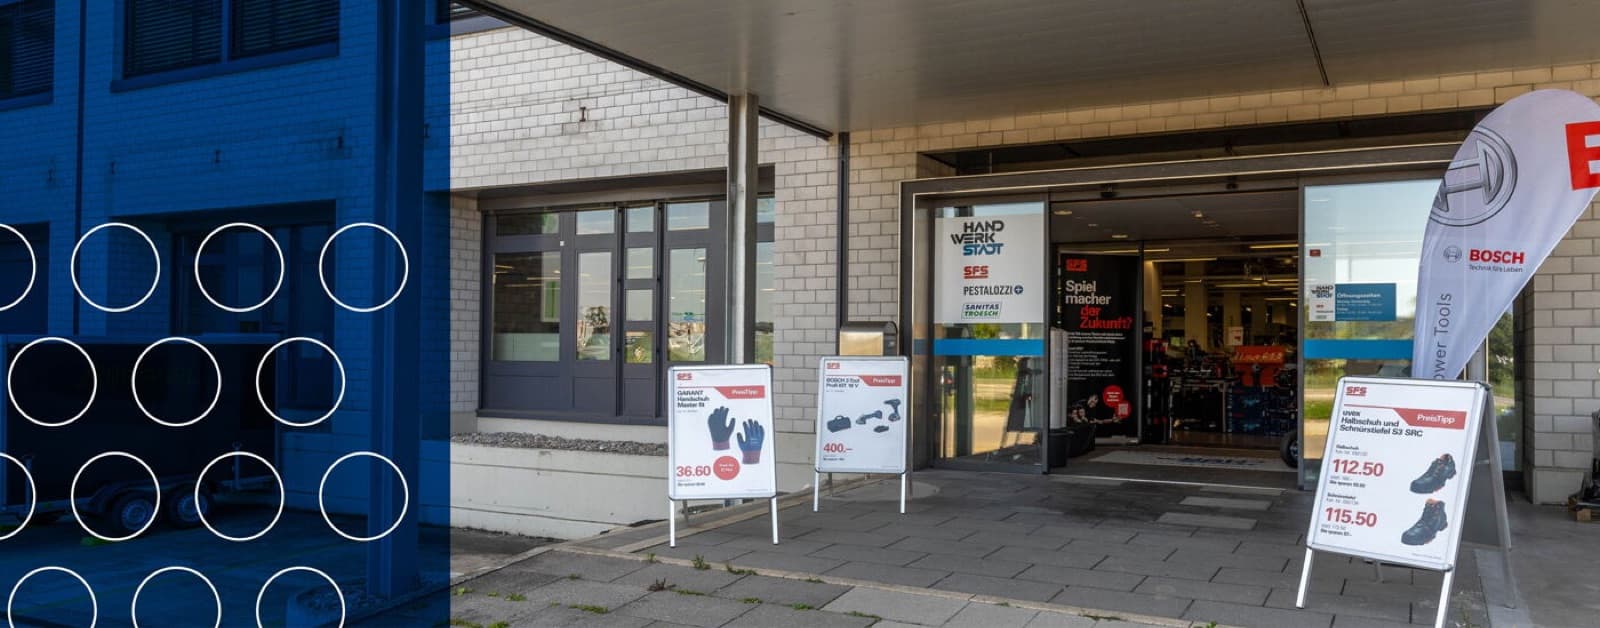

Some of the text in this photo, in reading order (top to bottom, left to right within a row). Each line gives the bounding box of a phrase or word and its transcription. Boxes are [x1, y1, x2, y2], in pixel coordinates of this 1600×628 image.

[963, 220, 1004, 233] HAND
[950, 233, 995, 244] WERK
[1469, 249, 1525, 264] BOSCH
[963, 266, 989, 278] SFS
[963, 285, 1013, 297] PESTALOZZI
[1065, 280, 1096, 294] Spiel
[1065, 293, 1112, 305] macher
[964, 303, 1000, 311] SANITAS
[1080, 305, 1101, 317] der
[1433, 293, 1452, 336] Tools
[1080, 316, 1133, 329] Zukunft?
[1345, 386, 1367, 397] SFS
[1341, 416, 1382, 427] Halbschuh
[1416, 414, 1456, 425] PreisTipp
[1339, 424, 1391, 435] Schnürstiefel
[1404, 429, 1423, 437] SRC
[676, 465, 711, 477] 36.60
[1332, 458, 1384, 477] 112.50
[1325, 507, 1377, 527] 115.50
